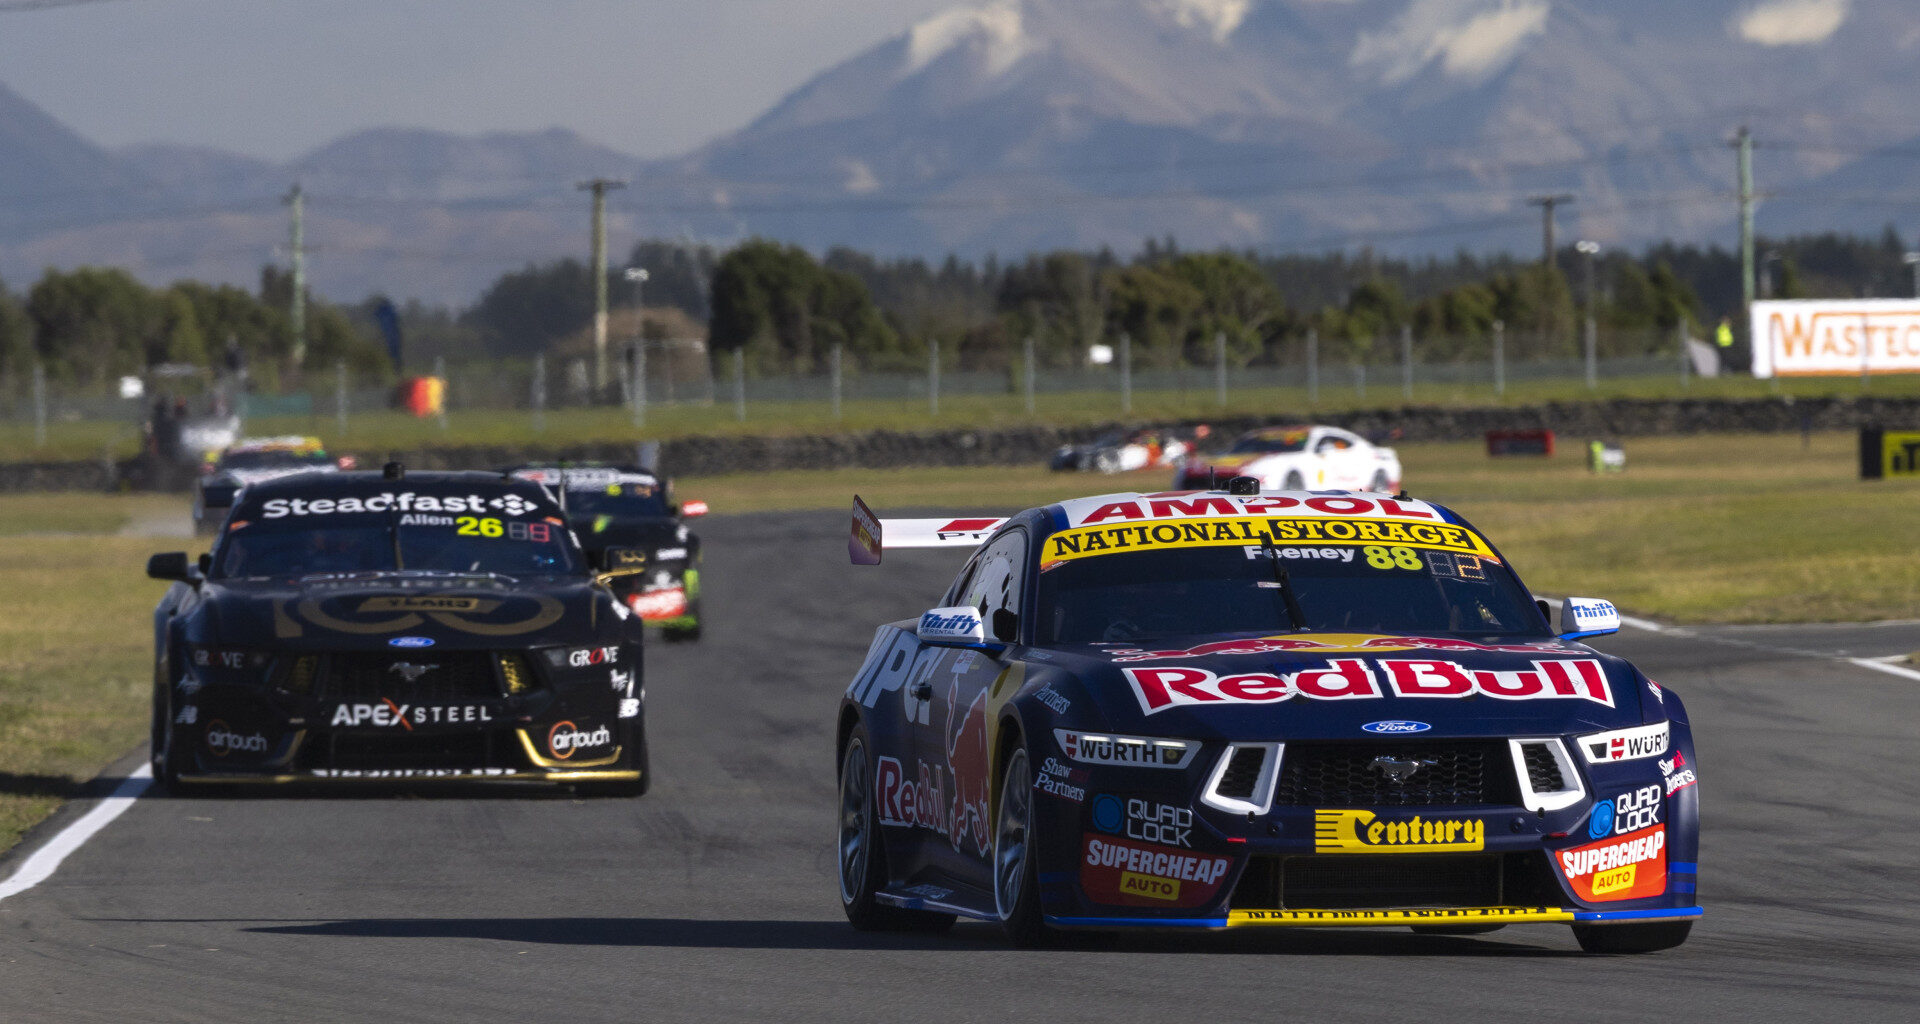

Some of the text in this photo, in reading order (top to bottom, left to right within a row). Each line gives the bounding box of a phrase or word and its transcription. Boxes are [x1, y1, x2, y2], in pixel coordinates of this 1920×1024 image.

[263, 493, 488, 518] Steadfast
[1080, 496, 1434, 524] AMPOL
[400, 513, 504, 537] Allen 26
[1053, 520, 1469, 557] NATIONAL STORAGE
[1244, 545, 1424, 570] Feeney 88
[921, 613, 981, 634] Thrifty
[569, 647, 619, 667] GROVE
[1121, 659, 1384, 716] Red
[1376, 659, 1615, 708] Bull
[331, 697, 492, 731] APEX STEEL
[1376, 721, 1417, 732] Ford
[552, 724, 610, 750] airtouch
[1041, 757, 1072, 779] Shaw
[1032, 771, 1085, 802] Partners
[1617, 784, 1661, 814] QUAD
[1127, 799, 1193, 828] QUAD
[1615, 804, 1659, 834] LOCK
[1126, 819, 1192, 848] LOCK
[1315, 809, 1484, 853] Century
[1087, 840, 1228, 885] SUPERCHEAP
[1562, 831, 1664, 879] SUPERCHEAP
[1126, 877, 1173, 895] AUTO
[1597, 871, 1630, 889] AUTO
